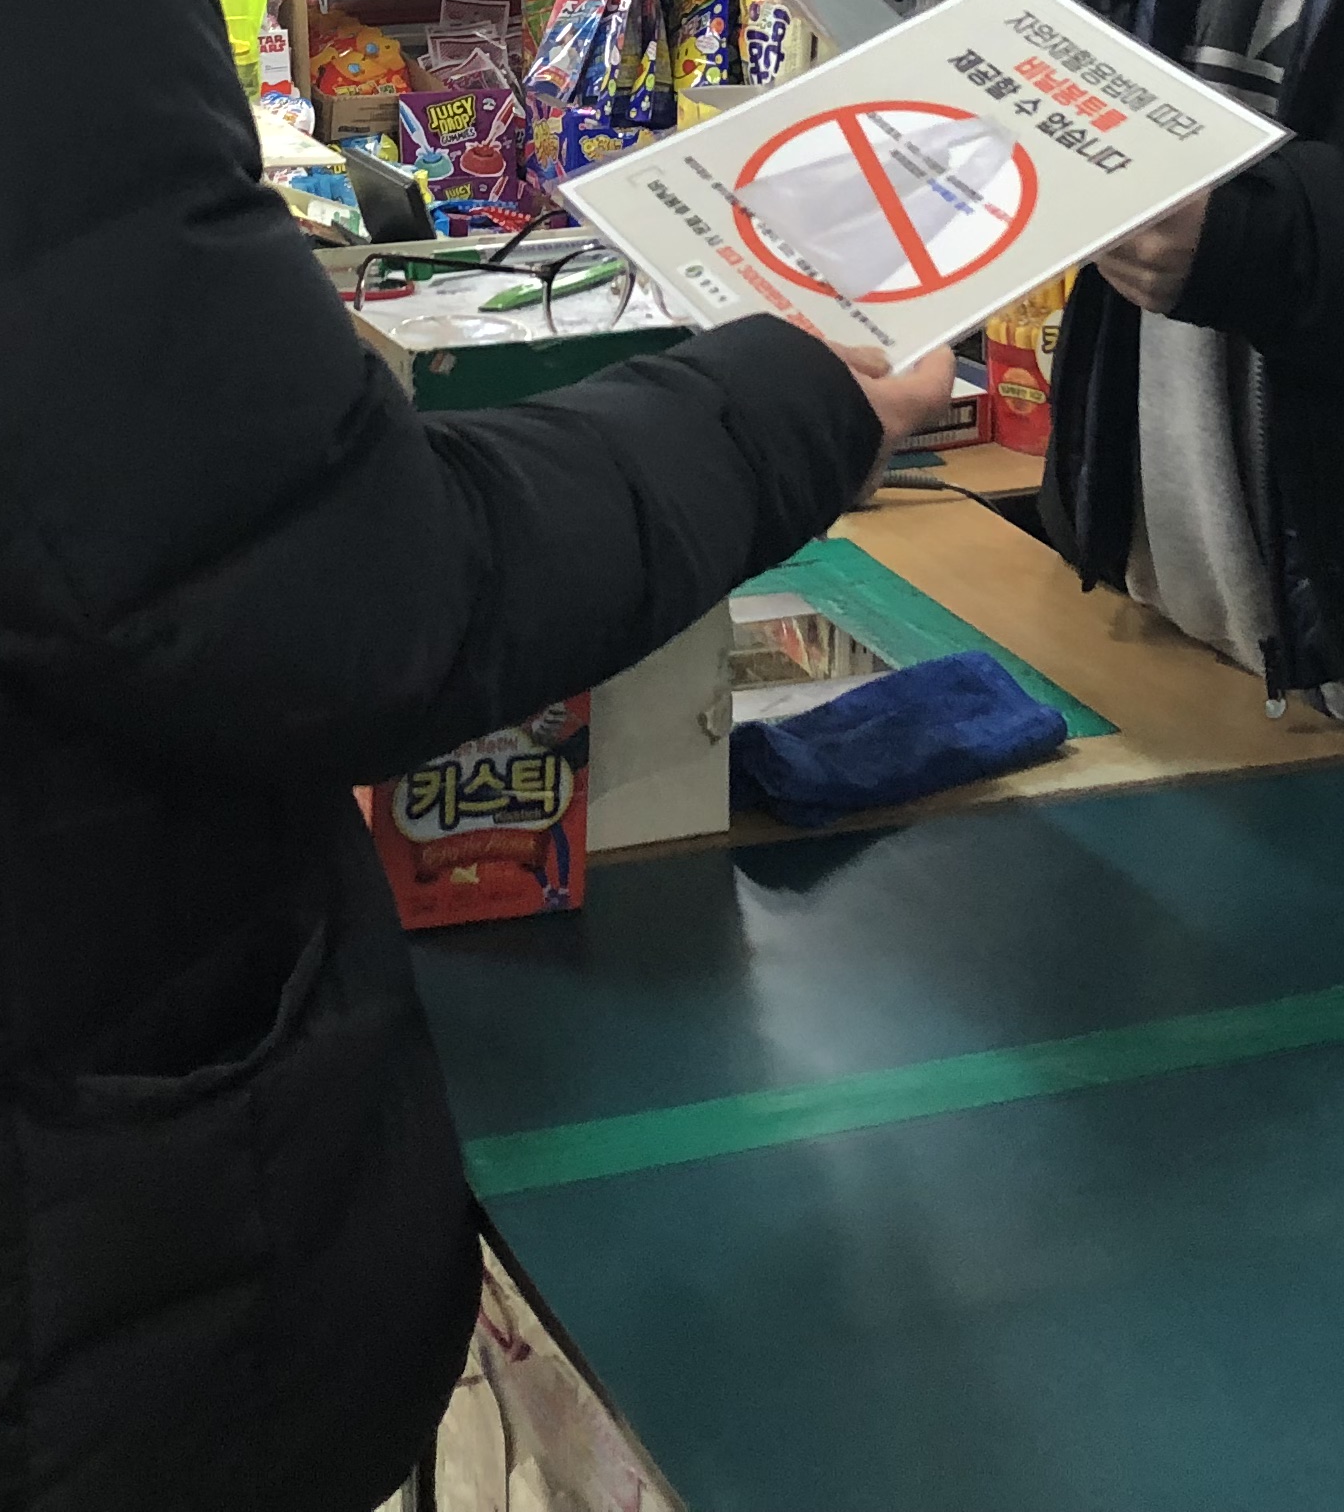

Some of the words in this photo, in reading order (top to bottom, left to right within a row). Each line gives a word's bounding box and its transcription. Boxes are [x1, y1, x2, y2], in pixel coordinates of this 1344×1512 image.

[428, 96, 473, 129] JUICY
[947, 48, 1023, 101] 제공할
[1013, 97, 1042, 116] 수
[1035, 112, 1134, 175] 없습니다
[1003, 9, 1158, 113] 자원재활용법에
[1146, 102, 1206, 141] 따라
[1013, 55, 1129, 133] 비닐봉투를
[439, 114, 470, 135] DROP
[408, 752, 558, 829] 키스틱
